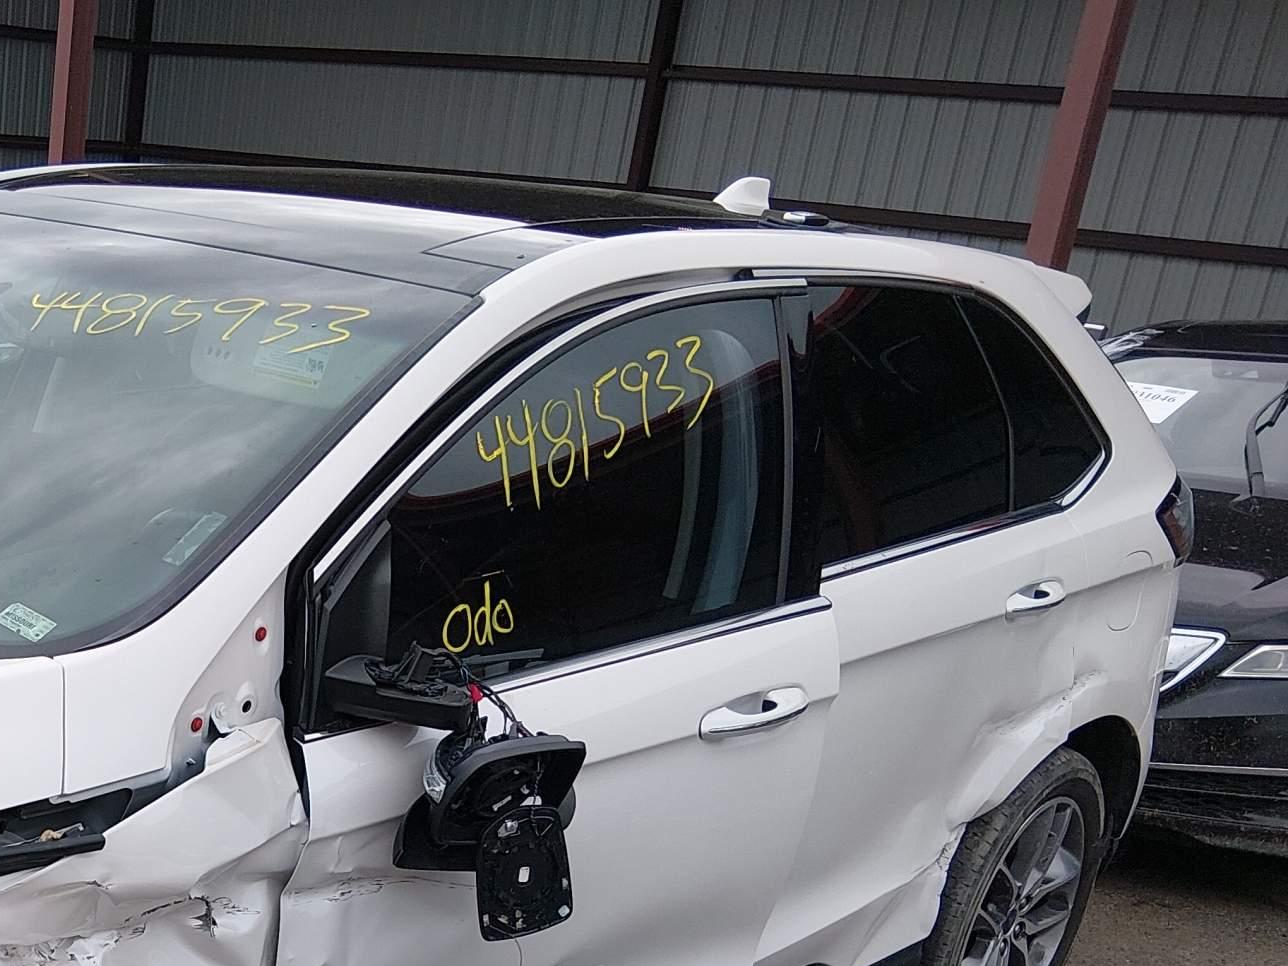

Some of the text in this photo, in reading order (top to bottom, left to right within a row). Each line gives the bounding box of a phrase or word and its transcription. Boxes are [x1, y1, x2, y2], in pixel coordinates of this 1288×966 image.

[30, 291, 371, 354] 44815933
[476, 335, 714, 510] 44815933
[441, 580, 514, 653] Odo
